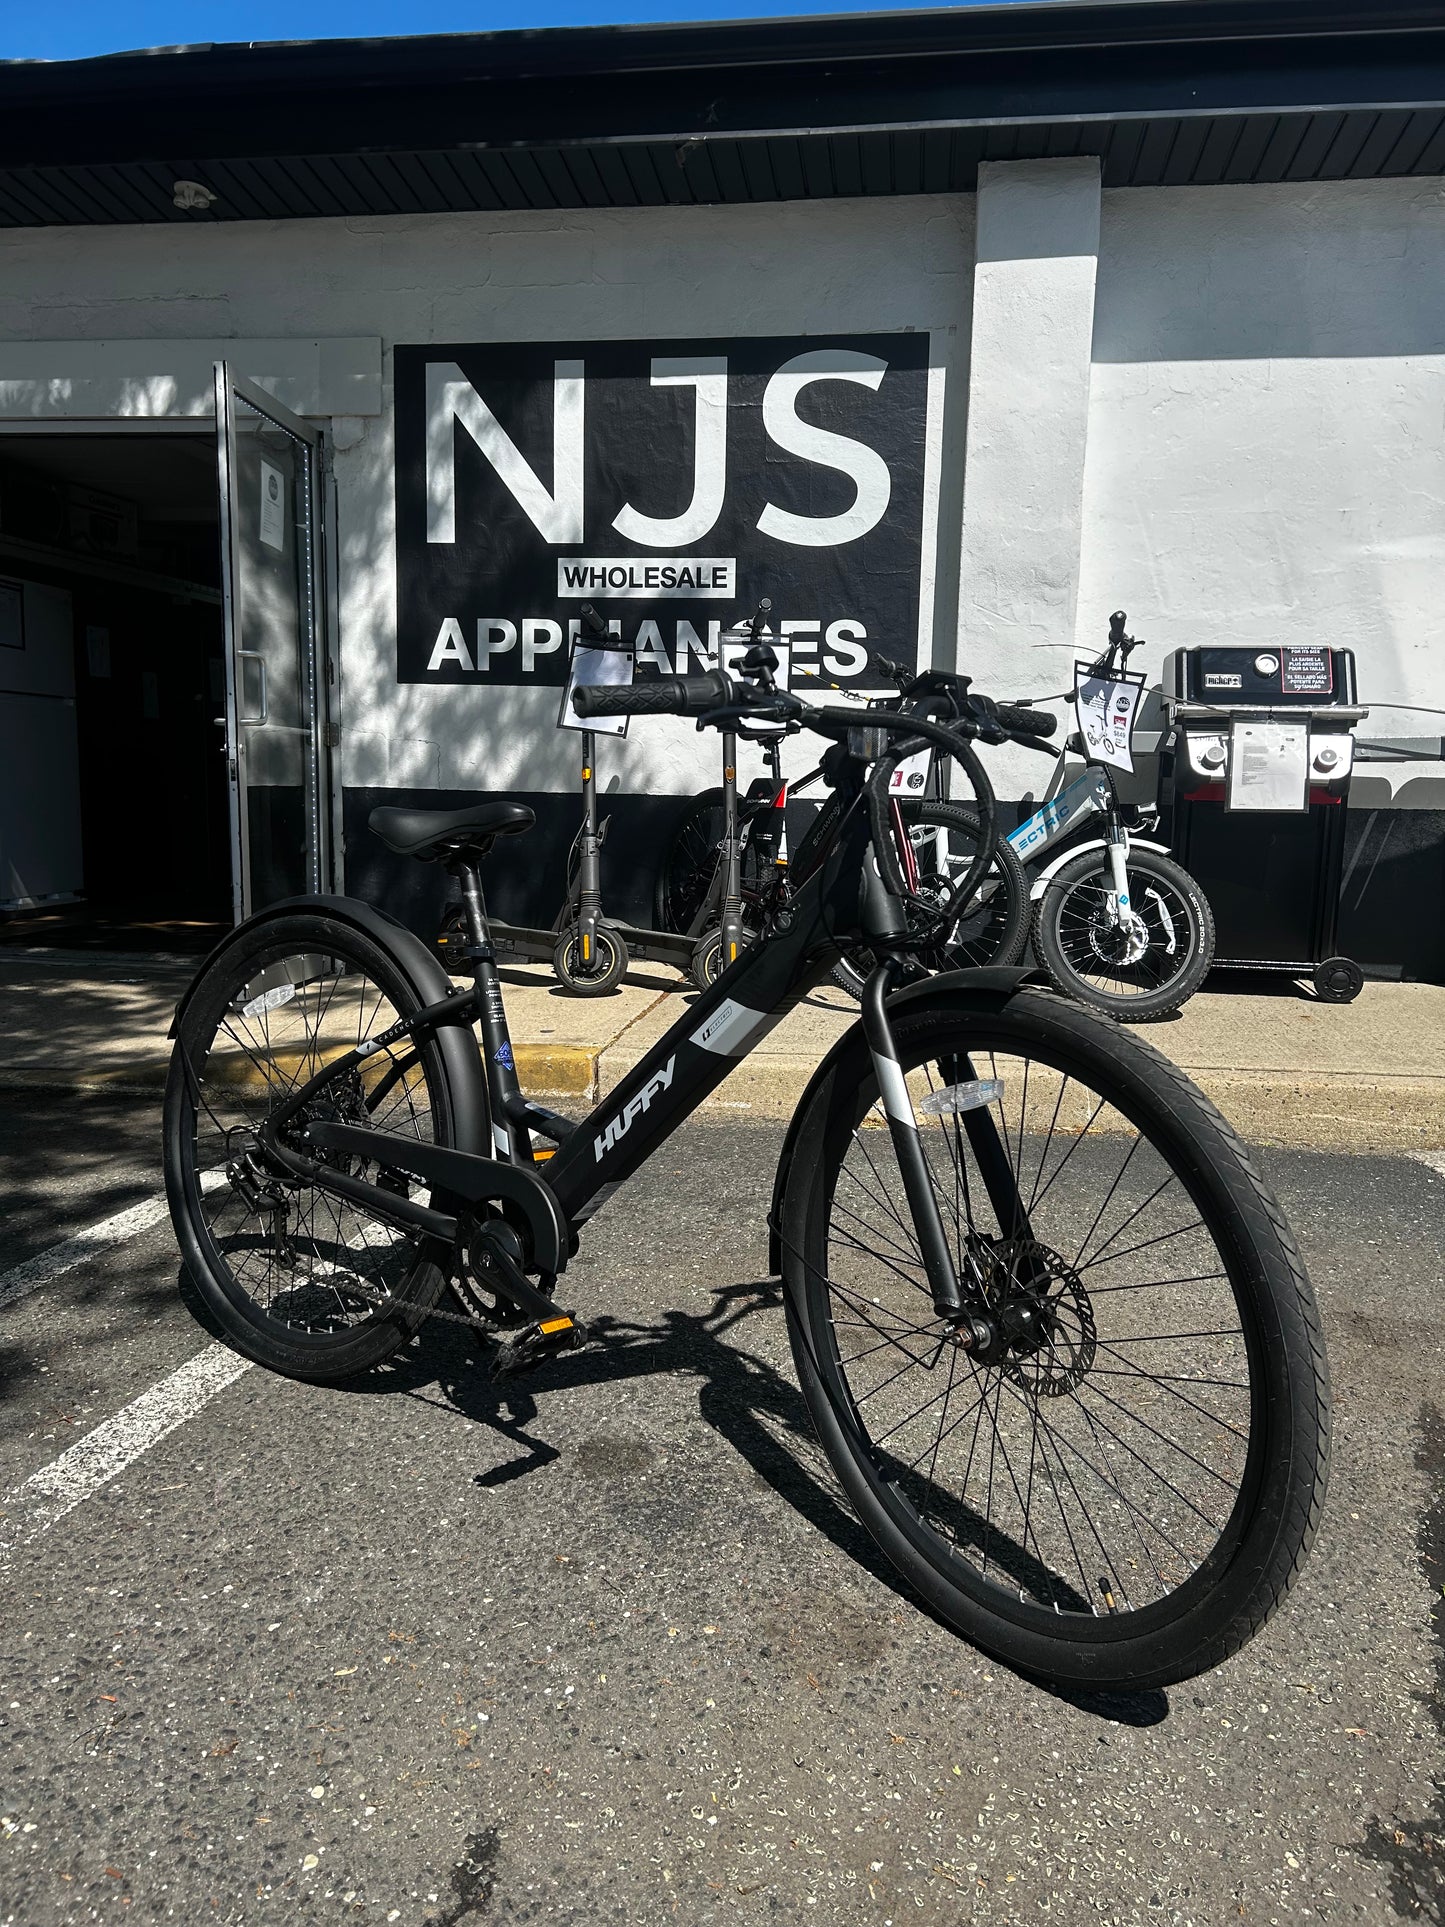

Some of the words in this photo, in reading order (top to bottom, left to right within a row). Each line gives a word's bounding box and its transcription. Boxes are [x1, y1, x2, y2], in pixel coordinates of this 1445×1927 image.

[425, 349, 892, 548] NJS
[564, 566, 728, 589] WHOLESALE
[427, 617, 868, 677] APPANES
[1016, 805, 1070, 854] ECTRIC
[1188, 892, 1205, 925] LECTRIC
[379, 1018, 415, 1042] CADENCE
[593, 1053, 677, 1163] HUFFY
